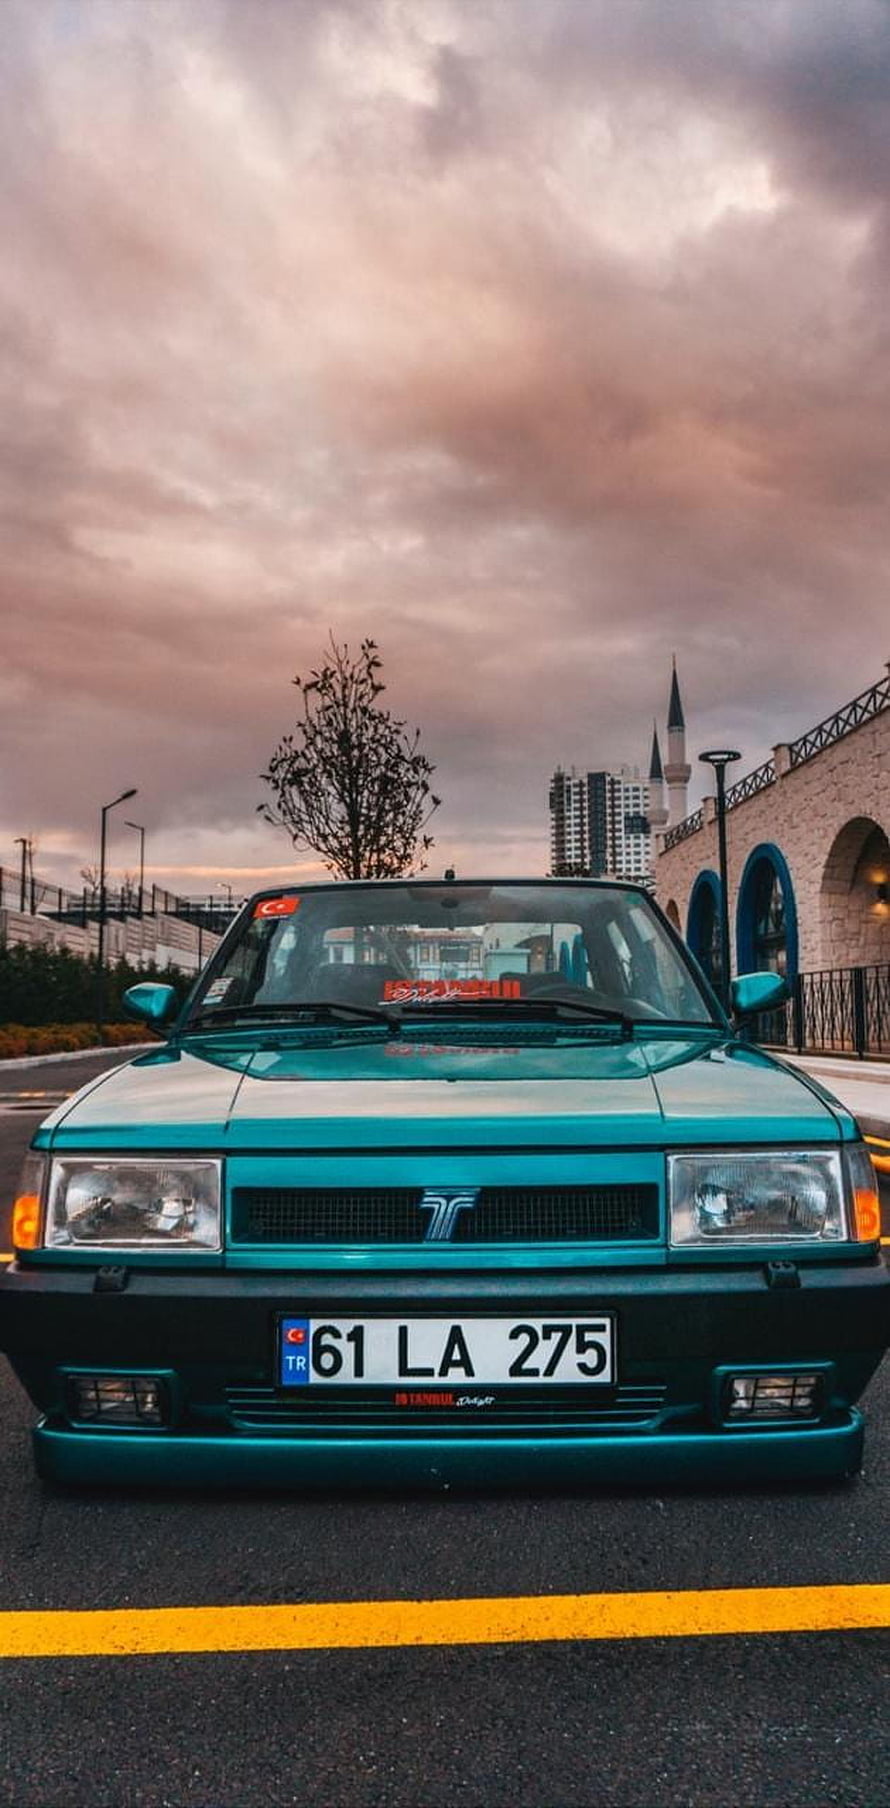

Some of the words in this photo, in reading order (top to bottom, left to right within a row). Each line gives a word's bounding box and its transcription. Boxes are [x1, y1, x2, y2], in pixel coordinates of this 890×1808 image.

[285, 1355, 306, 1371] TR
[311, 1324, 364, 1378] 61
[398, 1324, 475, 1378] LA
[508, 1323, 607, 1377] 275
